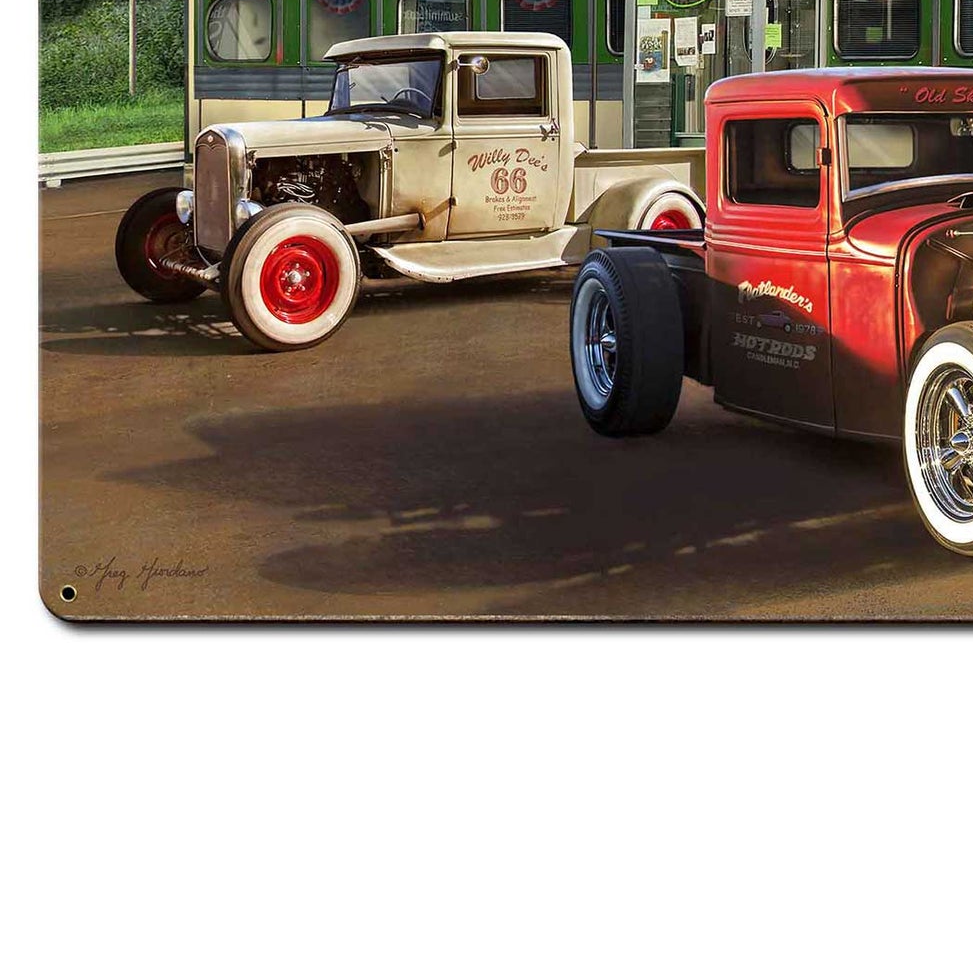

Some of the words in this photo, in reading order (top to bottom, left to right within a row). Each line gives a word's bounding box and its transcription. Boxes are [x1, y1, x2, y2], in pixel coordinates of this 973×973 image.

[914, 87, 947, 104] Old
[467, 148, 510, 172] Willy
[515, 148, 548, 171] Dee's
[490, 167, 528, 195] 66
[485, 196, 505, 204] Brakes
